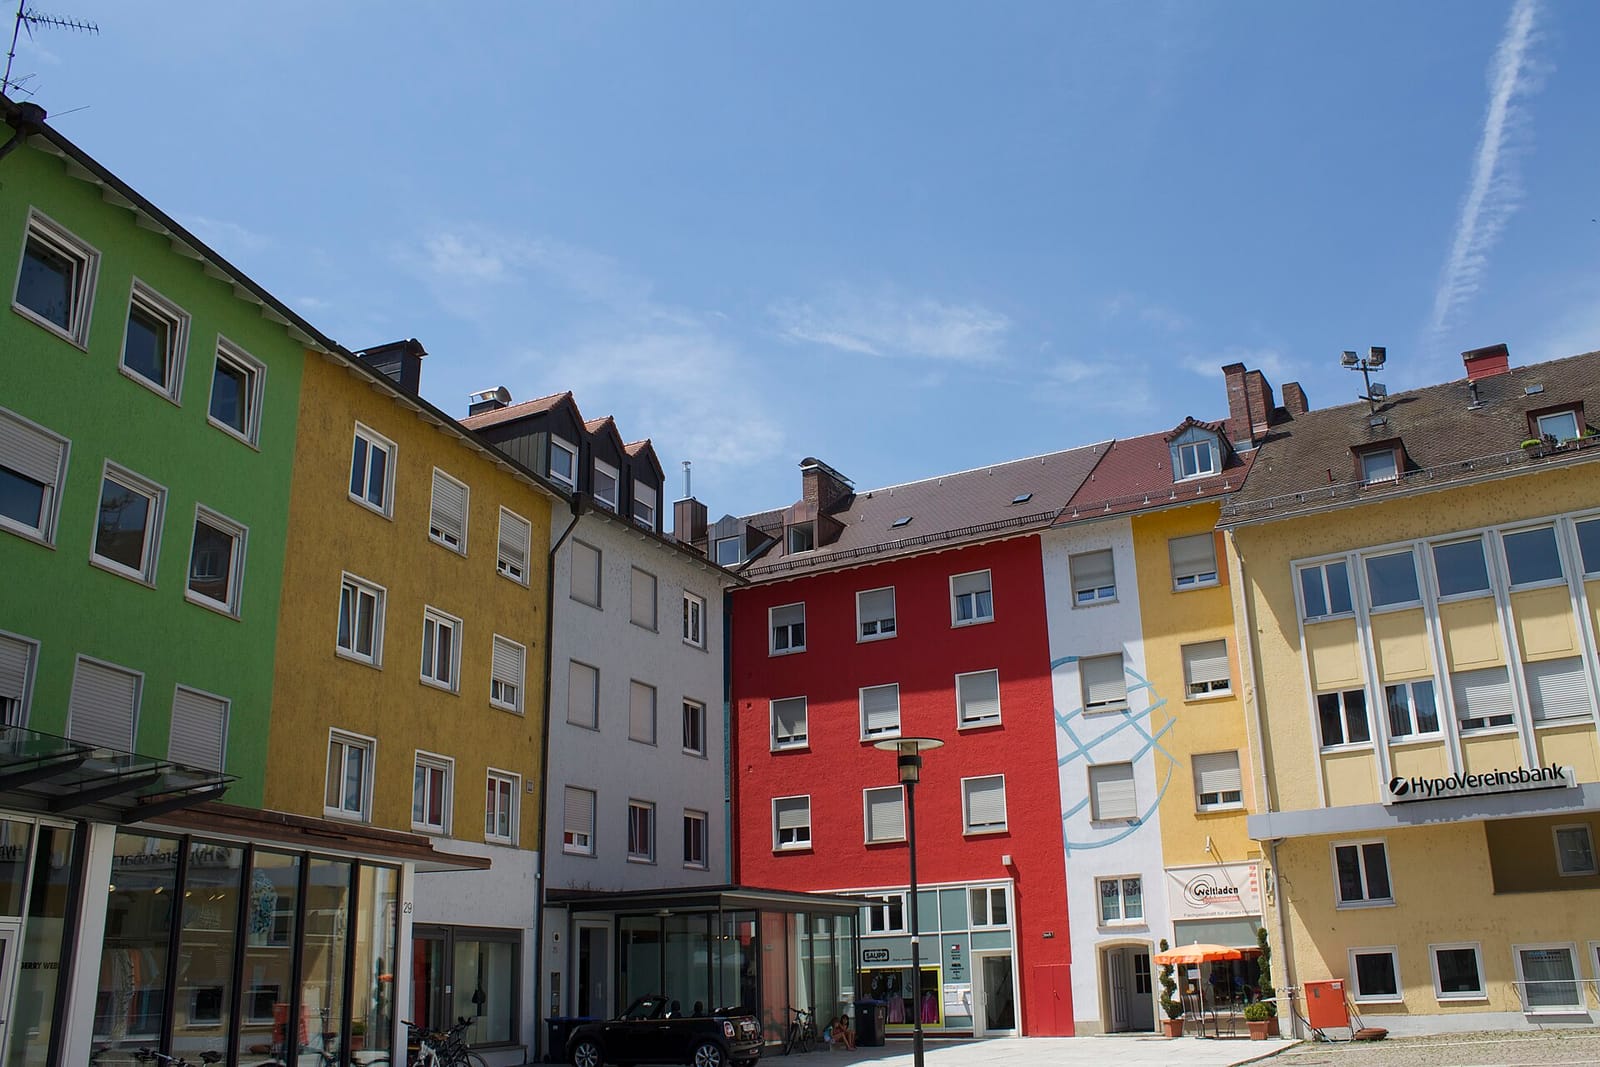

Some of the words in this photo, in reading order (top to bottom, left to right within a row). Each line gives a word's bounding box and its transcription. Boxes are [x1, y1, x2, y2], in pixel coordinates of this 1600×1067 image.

[1411, 763, 1565, 797] HypoVereinsbank
[1194, 884, 1239, 897] Weltladen
[403, 902, 412, 914] 29
